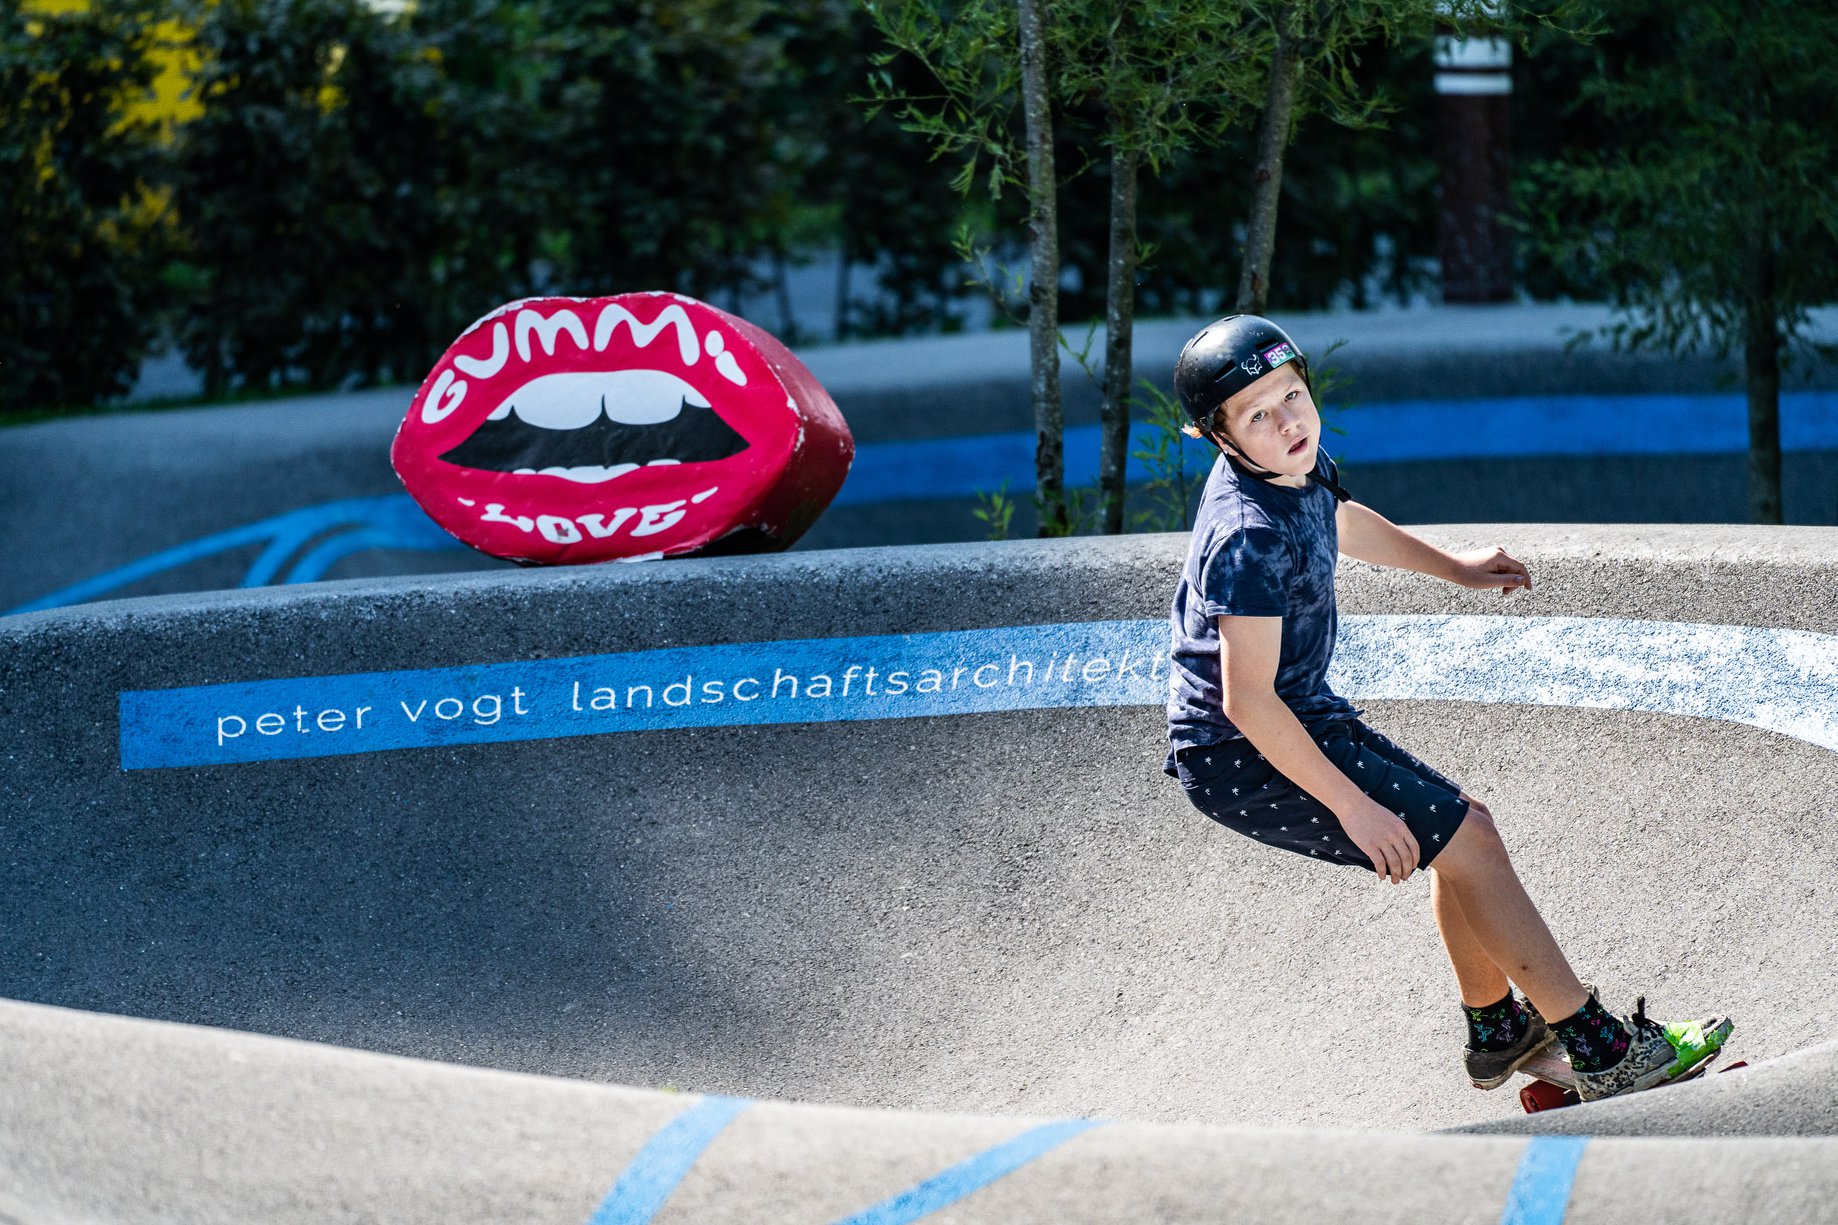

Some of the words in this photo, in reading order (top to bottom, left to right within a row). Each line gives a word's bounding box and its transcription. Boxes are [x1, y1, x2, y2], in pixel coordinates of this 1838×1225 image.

[480, 502, 687, 544] LOVE
[217, 704, 372, 746] peter
[401, 686, 529, 725] vogt
[571, 649, 1166, 712] landschaftsarchitekt
